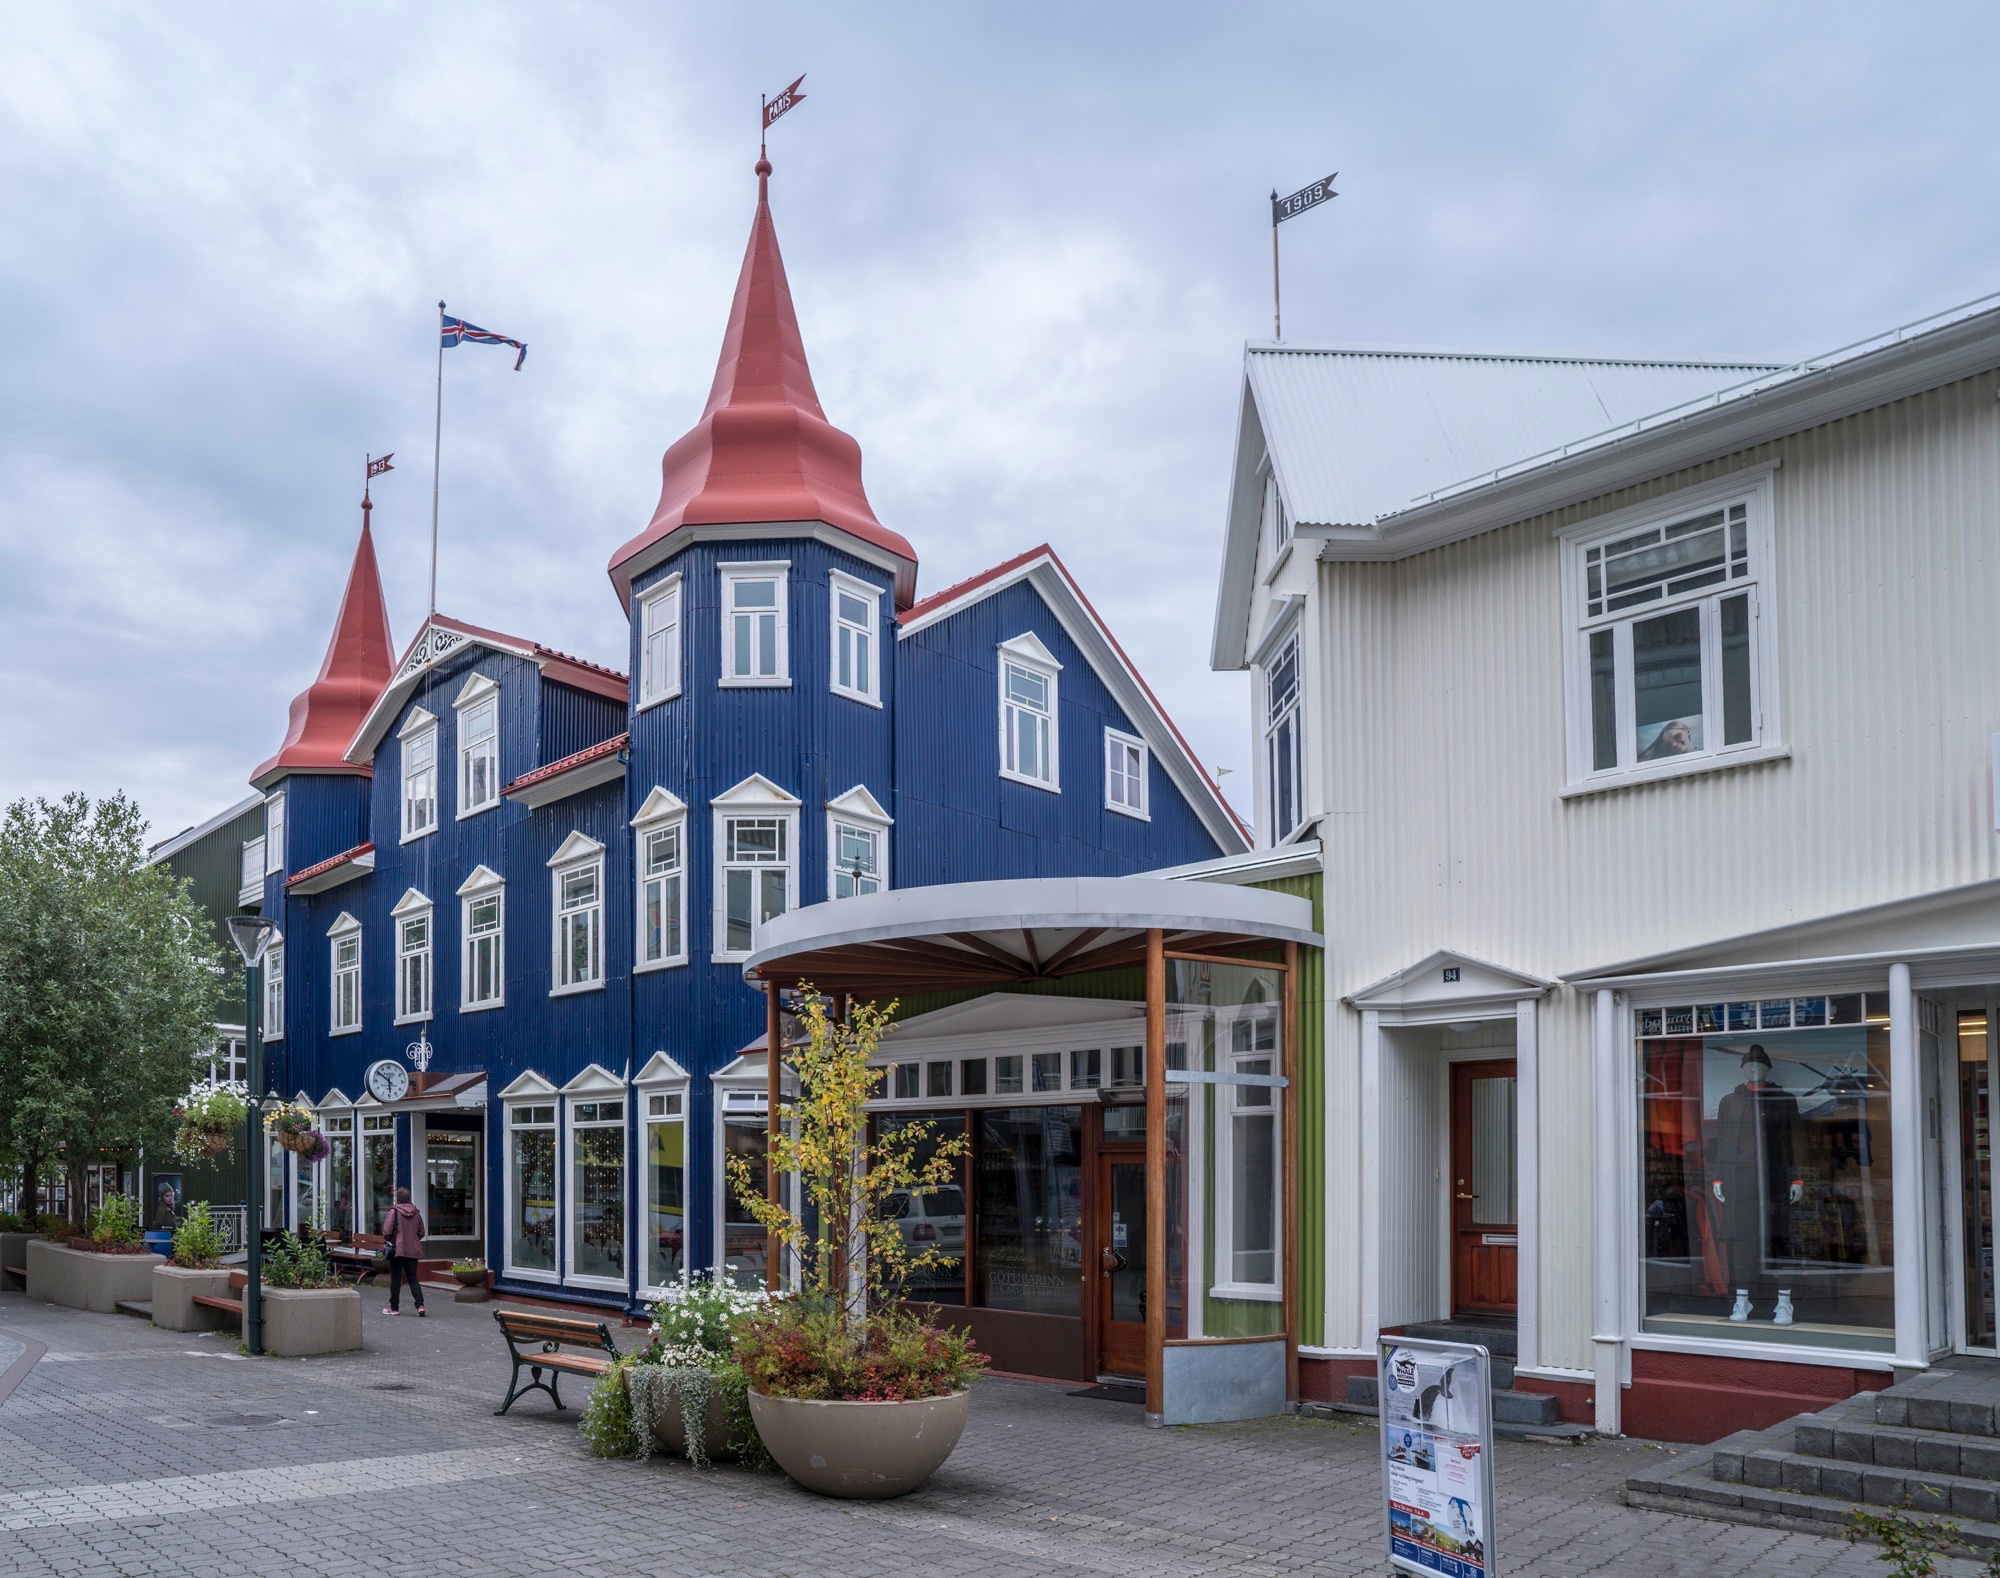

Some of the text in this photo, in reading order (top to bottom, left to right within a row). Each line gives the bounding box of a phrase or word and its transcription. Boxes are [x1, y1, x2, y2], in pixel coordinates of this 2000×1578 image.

[768, 92, 791, 121] PARIS
[1284, 185, 1323, 214] 1909
[1445, 969, 1457, 981] 94
